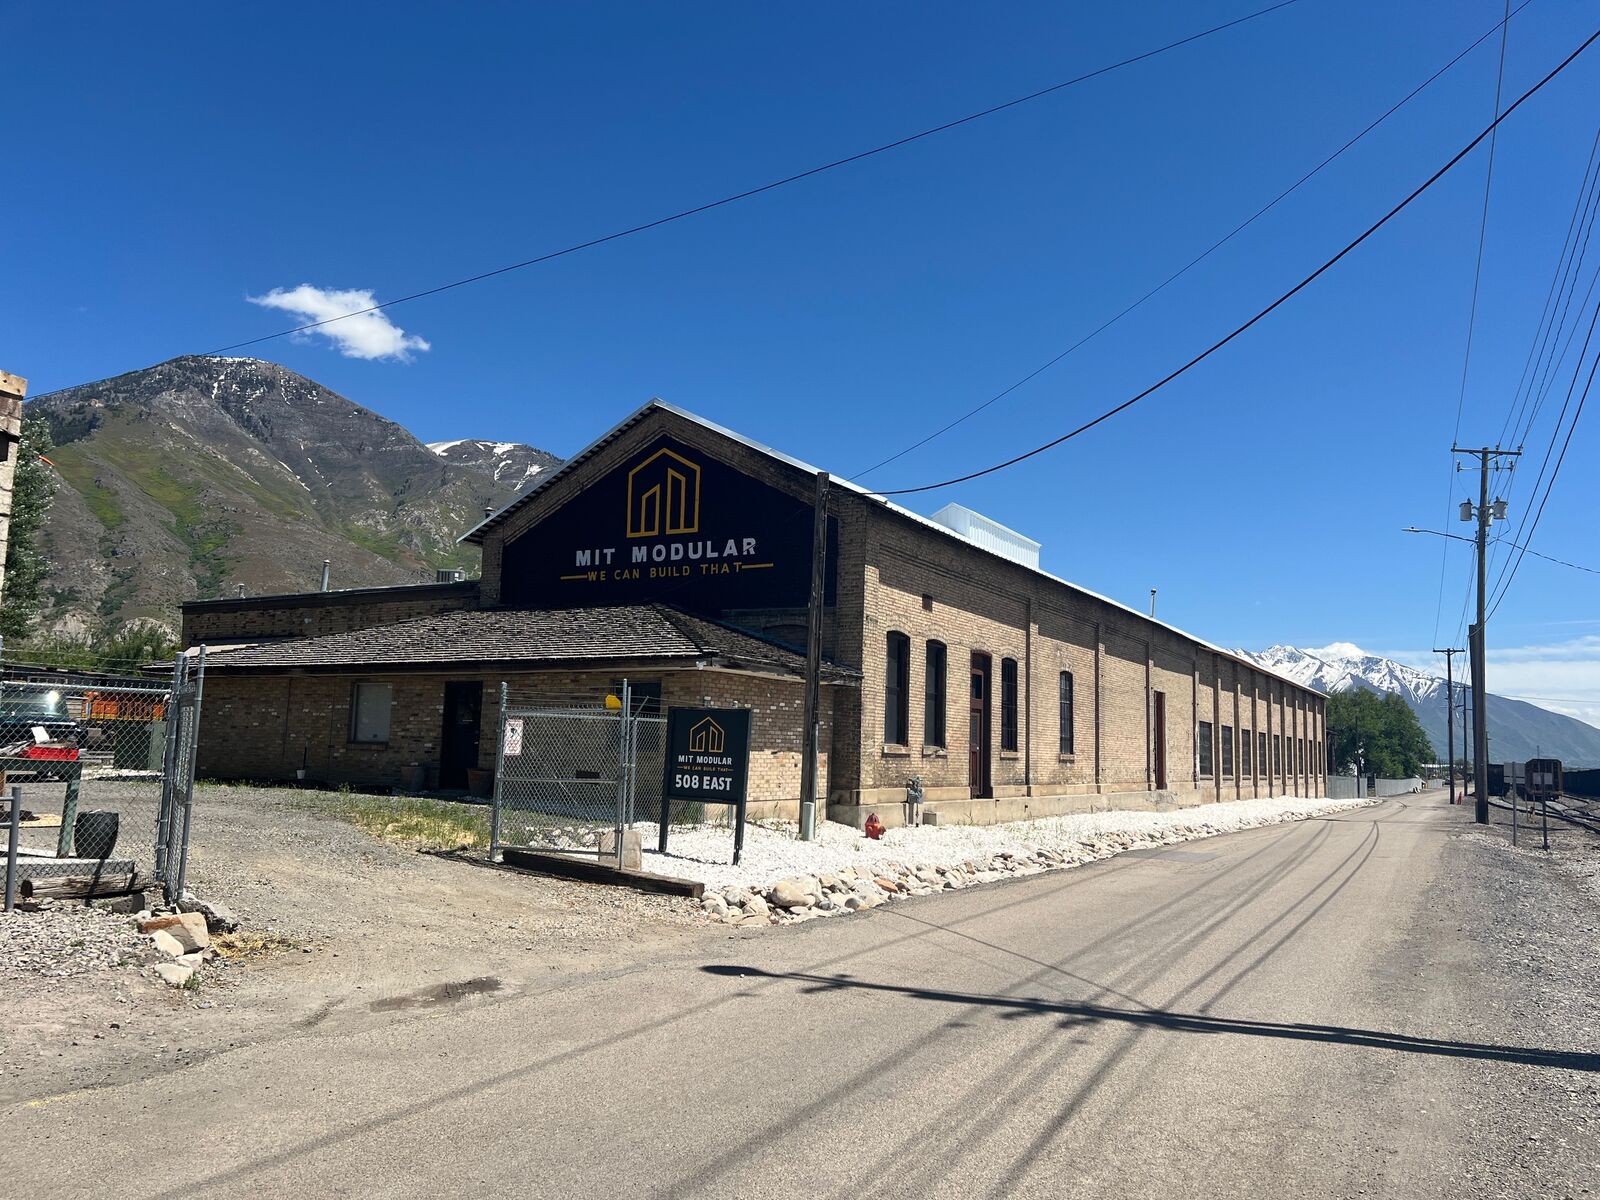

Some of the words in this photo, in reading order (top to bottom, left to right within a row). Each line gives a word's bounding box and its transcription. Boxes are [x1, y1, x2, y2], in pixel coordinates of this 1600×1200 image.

[575, 547, 616, 567] MIT
[632, 537, 757, 563] MODULAR
[587, 570, 606, 582] WE
[614, 568, 640, 580] CAN
[650, 565, 690, 578] BUILD
[700, 562, 742, 576] THAT
[678, 755, 694, 763] MIT
[696, 755, 733, 765] MODULAR
[675, 774, 699, 789] 508
[703, 776, 732, 791] EAST
